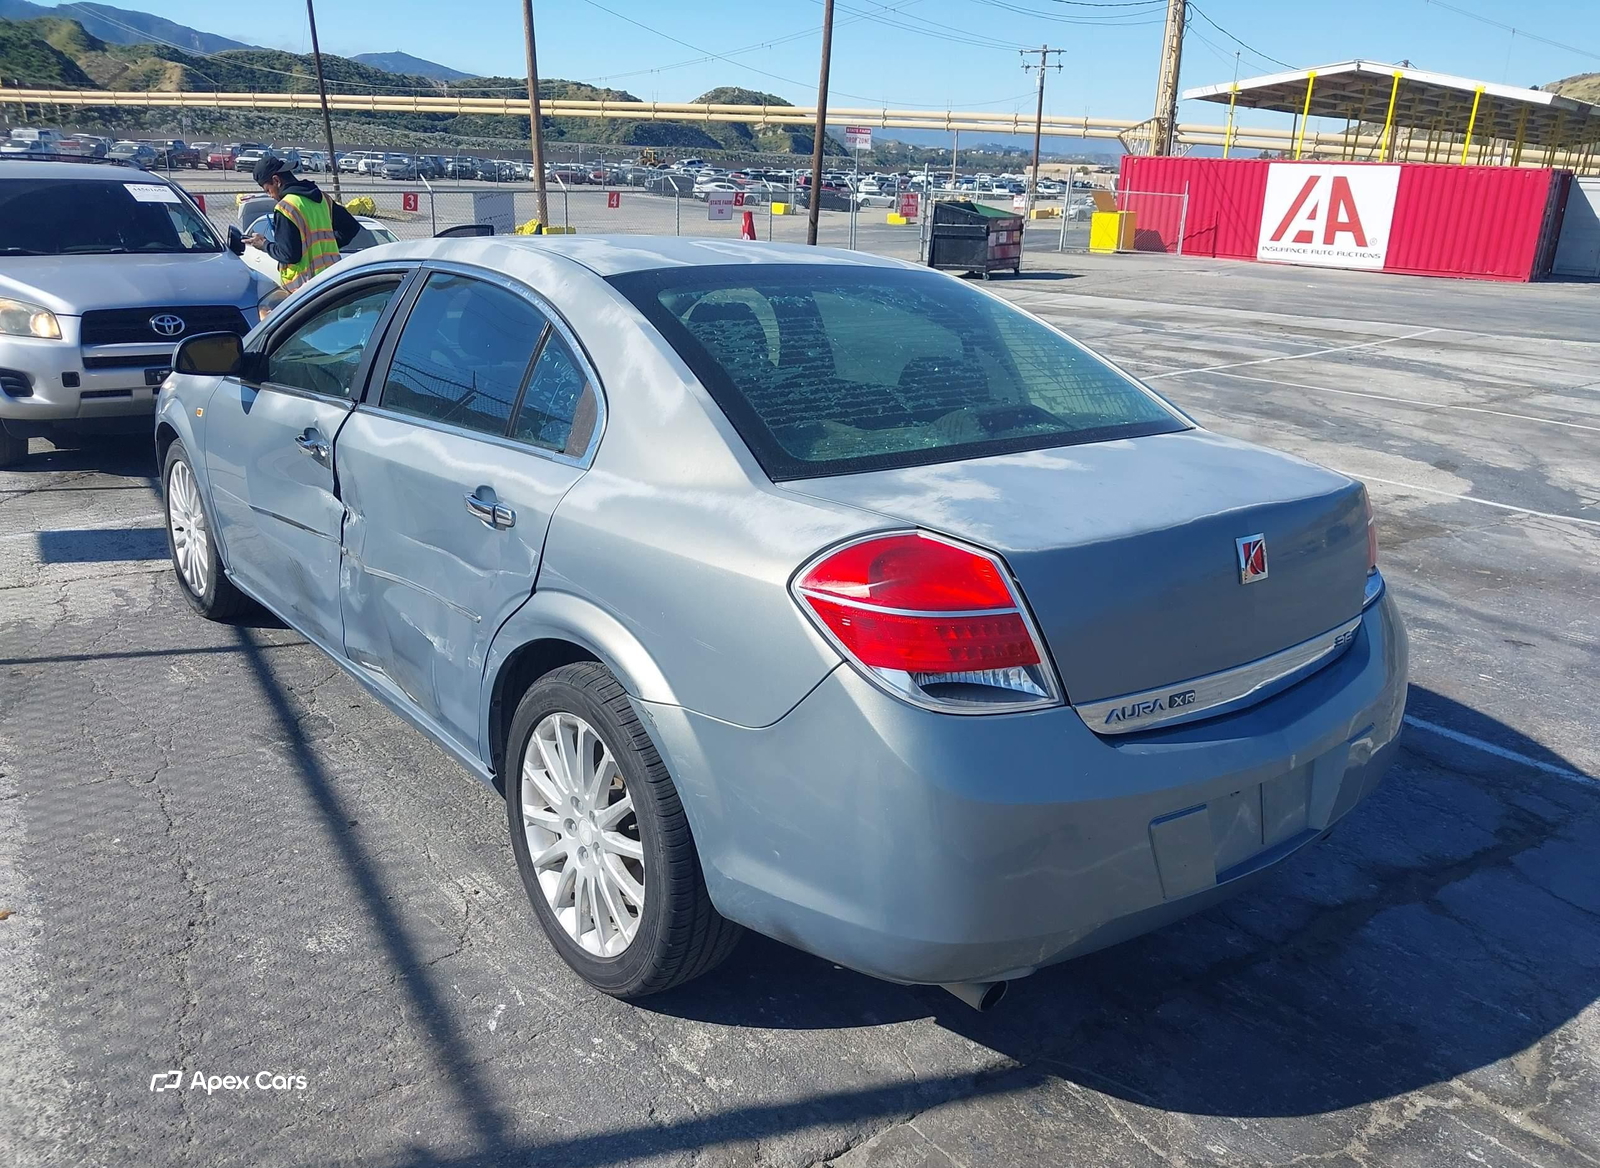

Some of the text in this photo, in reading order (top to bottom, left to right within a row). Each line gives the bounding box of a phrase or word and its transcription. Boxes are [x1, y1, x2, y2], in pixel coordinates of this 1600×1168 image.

[406, 194, 415, 210] 3
[610, 193, 618, 207] 4
[736, 193, 744, 206] 5
[1262, 246, 1308, 255] INSURANCE
[1336, 251, 1381, 260] AUCTIONS
[1105, 693, 1195, 724] AURA XR
